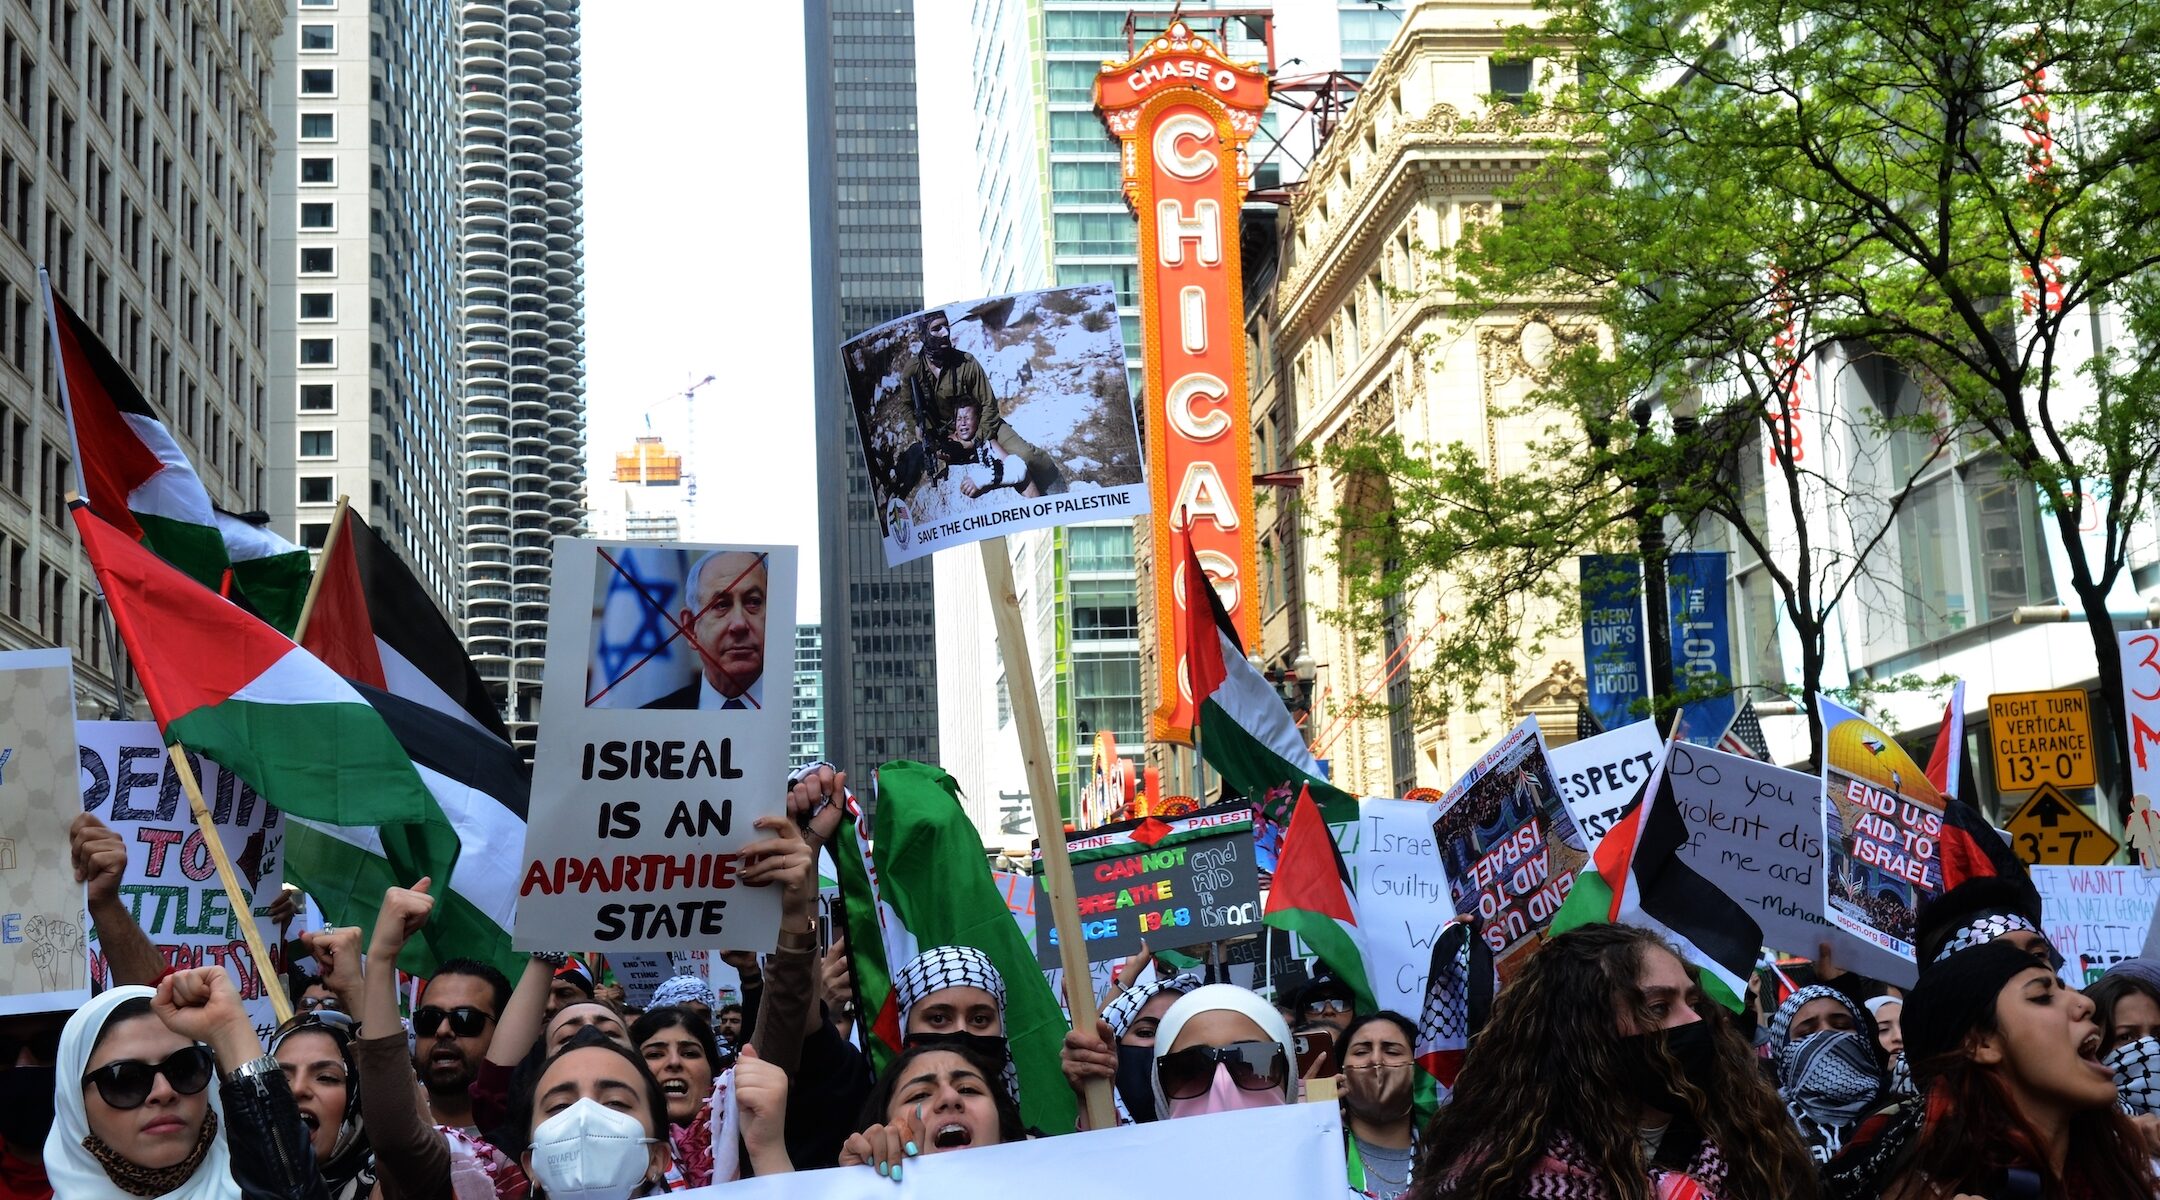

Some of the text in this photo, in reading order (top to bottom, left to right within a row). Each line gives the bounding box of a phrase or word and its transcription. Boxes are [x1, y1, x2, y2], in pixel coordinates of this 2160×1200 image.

[1127, 60, 1212, 91] CHASE
[1153, 113, 1240, 706] CHICAG
[917, 530, 939, 545] SAVE
[942, 520, 961, 537] THE
[962, 506, 1031, 531] CHILDREN
[1033, 502, 1052, 517] OF
[1055, 491, 1131, 513] PALESTINE
[1590, 607, 1634, 626] EVERY
[1689, 587, 1705, 614] THE
[1591, 625, 1636, 646] ONE'S
[1594, 660, 1637, 675] NEIGHBOR
[1595, 674, 1639, 694] HOOD
[1994, 697, 2084, 718] RIGHT TURN
[2006, 715, 2076, 735] VERTICAL
[581, 737, 743, 780] ISREAL
[2000, 735, 2087, 755] CLEARANCE
[1559, 751, 1653, 803] ESPECT
[1669, 747, 1721, 785] Do
[1745, 775, 1794, 807] you
[598, 799, 732, 839] IS AN
[1847, 779, 1897, 816] END
[1901, 802, 1941, 837] U.S.
[137, 827, 216, 882] TO
[1368, 815, 1431, 856] Israe
[1466, 819, 1542, 891] ISRAEL
[1855, 812, 1933, 860] AID TO
[1094, 847, 1187, 883] CANNOT
[1721, 850, 1760, 872] me
[1769, 863, 1812, 885] and
[1853, 836, 1935, 889] ISRAEL
[1372, 864, 1439, 904] Guilty
[1478, 850, 1550, 920] AID TO
[1527, 871, 1576, 923] END
[594, 900, 726, 941] STATE
[1139, 907, 1191, 934] 1948
[1837, 915, 1878, 942] uspcn.org
[630, 971, 659, 979] ETHNIC
[640, 960, 657, 968] THE
